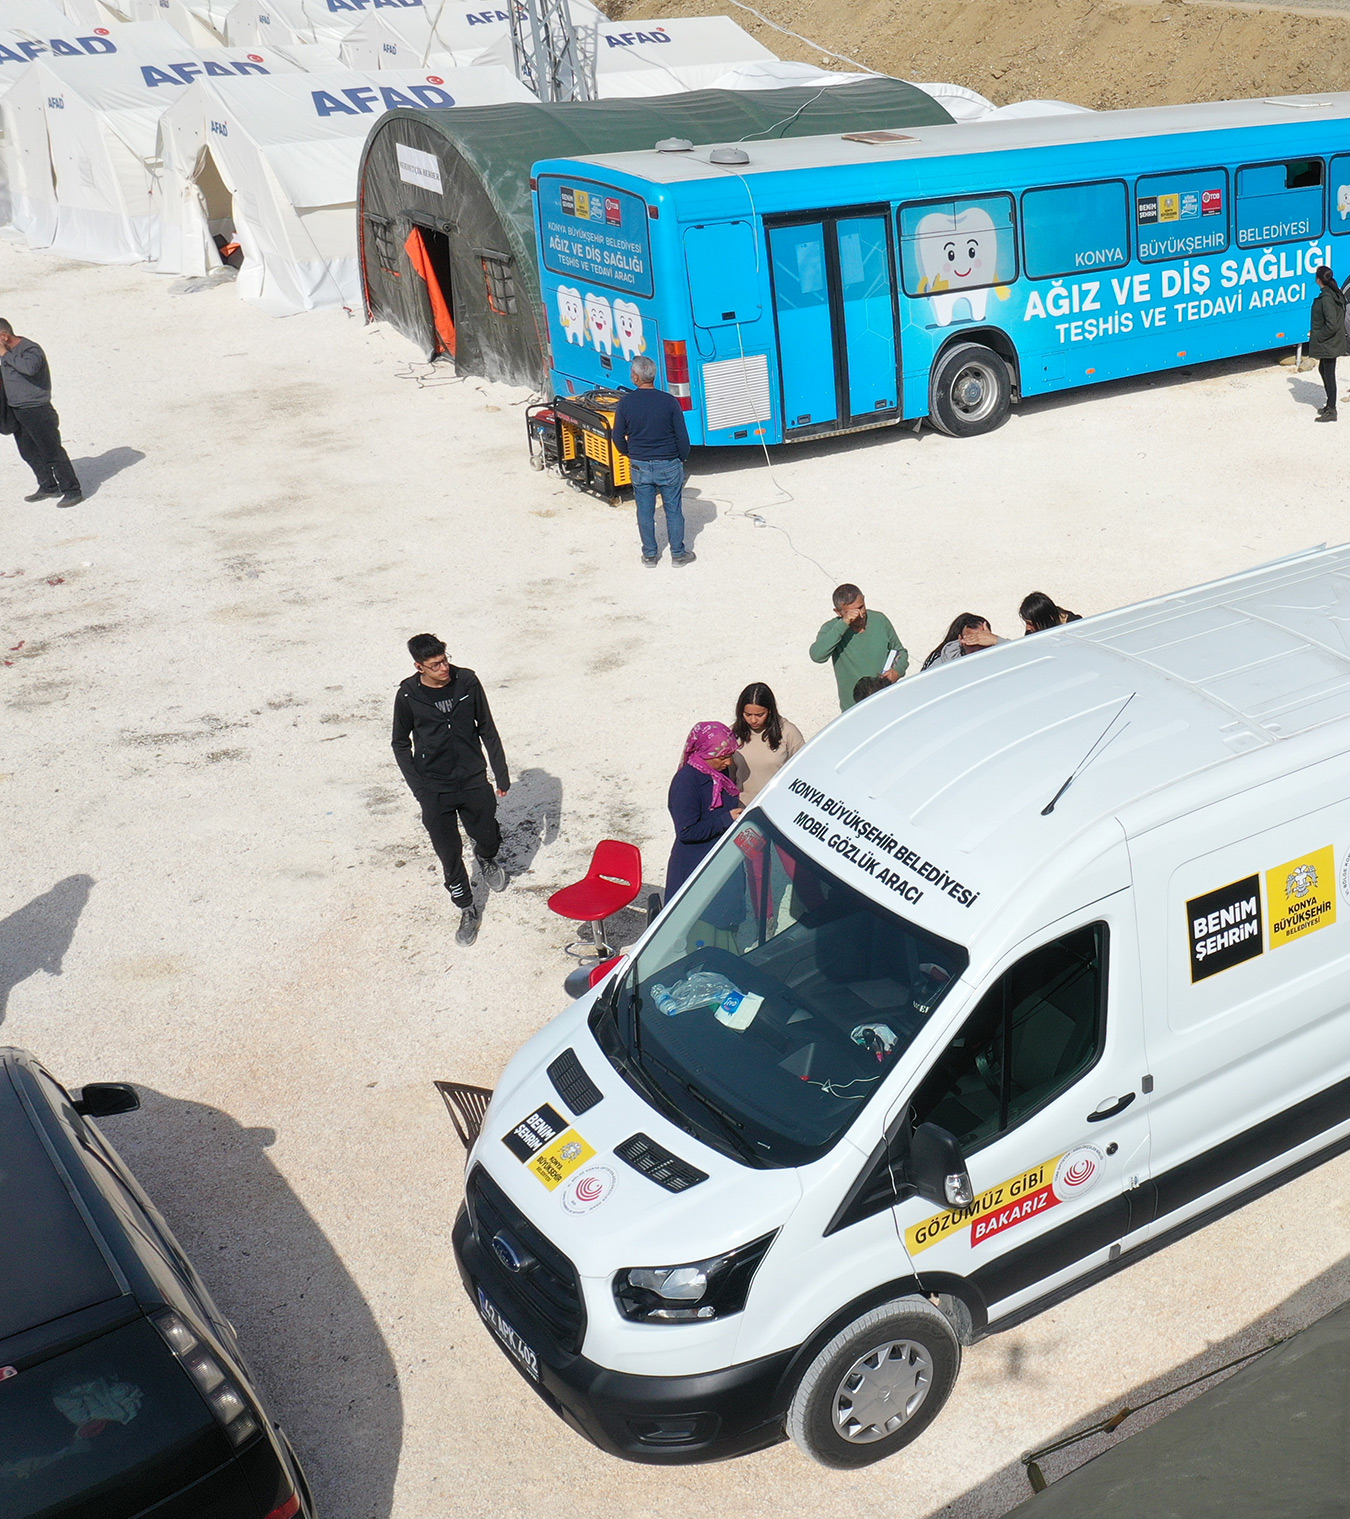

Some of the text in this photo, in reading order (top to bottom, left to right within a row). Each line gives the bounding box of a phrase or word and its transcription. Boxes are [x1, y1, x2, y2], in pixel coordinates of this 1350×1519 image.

[383, 43, 397, 55] AFAD
[605, 30, 672, 48] AFAD
[48, 97, 64, 109] AFAD
[311, 85, 456, 116] AFAD
[211, 120, 228, 136] AFAD
[548, 221, 567, 234] KONYA
[1075, 221, 1310, 267] KONYA BÜYÜKŞEHİR BELEDİYESİ
[549, 234, 644, 273] AĞIZ VE DİŞ SAĞLIĞI
[580, 261, 590, 272] VE
[614, 271, 635, 284] ARACI
[1023, 240, 1332, 322] AĞIZ VE DİŞ SAĞLIĞI
[1055, 283, 1306, 344] TEŞHİS VE TEDAVİ ARACI
[788, 778, 981, 909] KONYA BÜYÜKŞEHİR BELEDİYESİ
[793, 811, 829, 842] MOBİL
[827, 834, 879, 876] GÖZLÜK
[875, 867, 925, 905] ARACI
[1288, 896, 1317, 915] KONYA
[915, 1188, 1004, 1244] GÖZÜMÜZ
[1009, 1166, 1044, 1197] GİBİ
[975, 1191, 1049, 1239] BAKARIZ
[518, 1340, 539, 1374] 402
